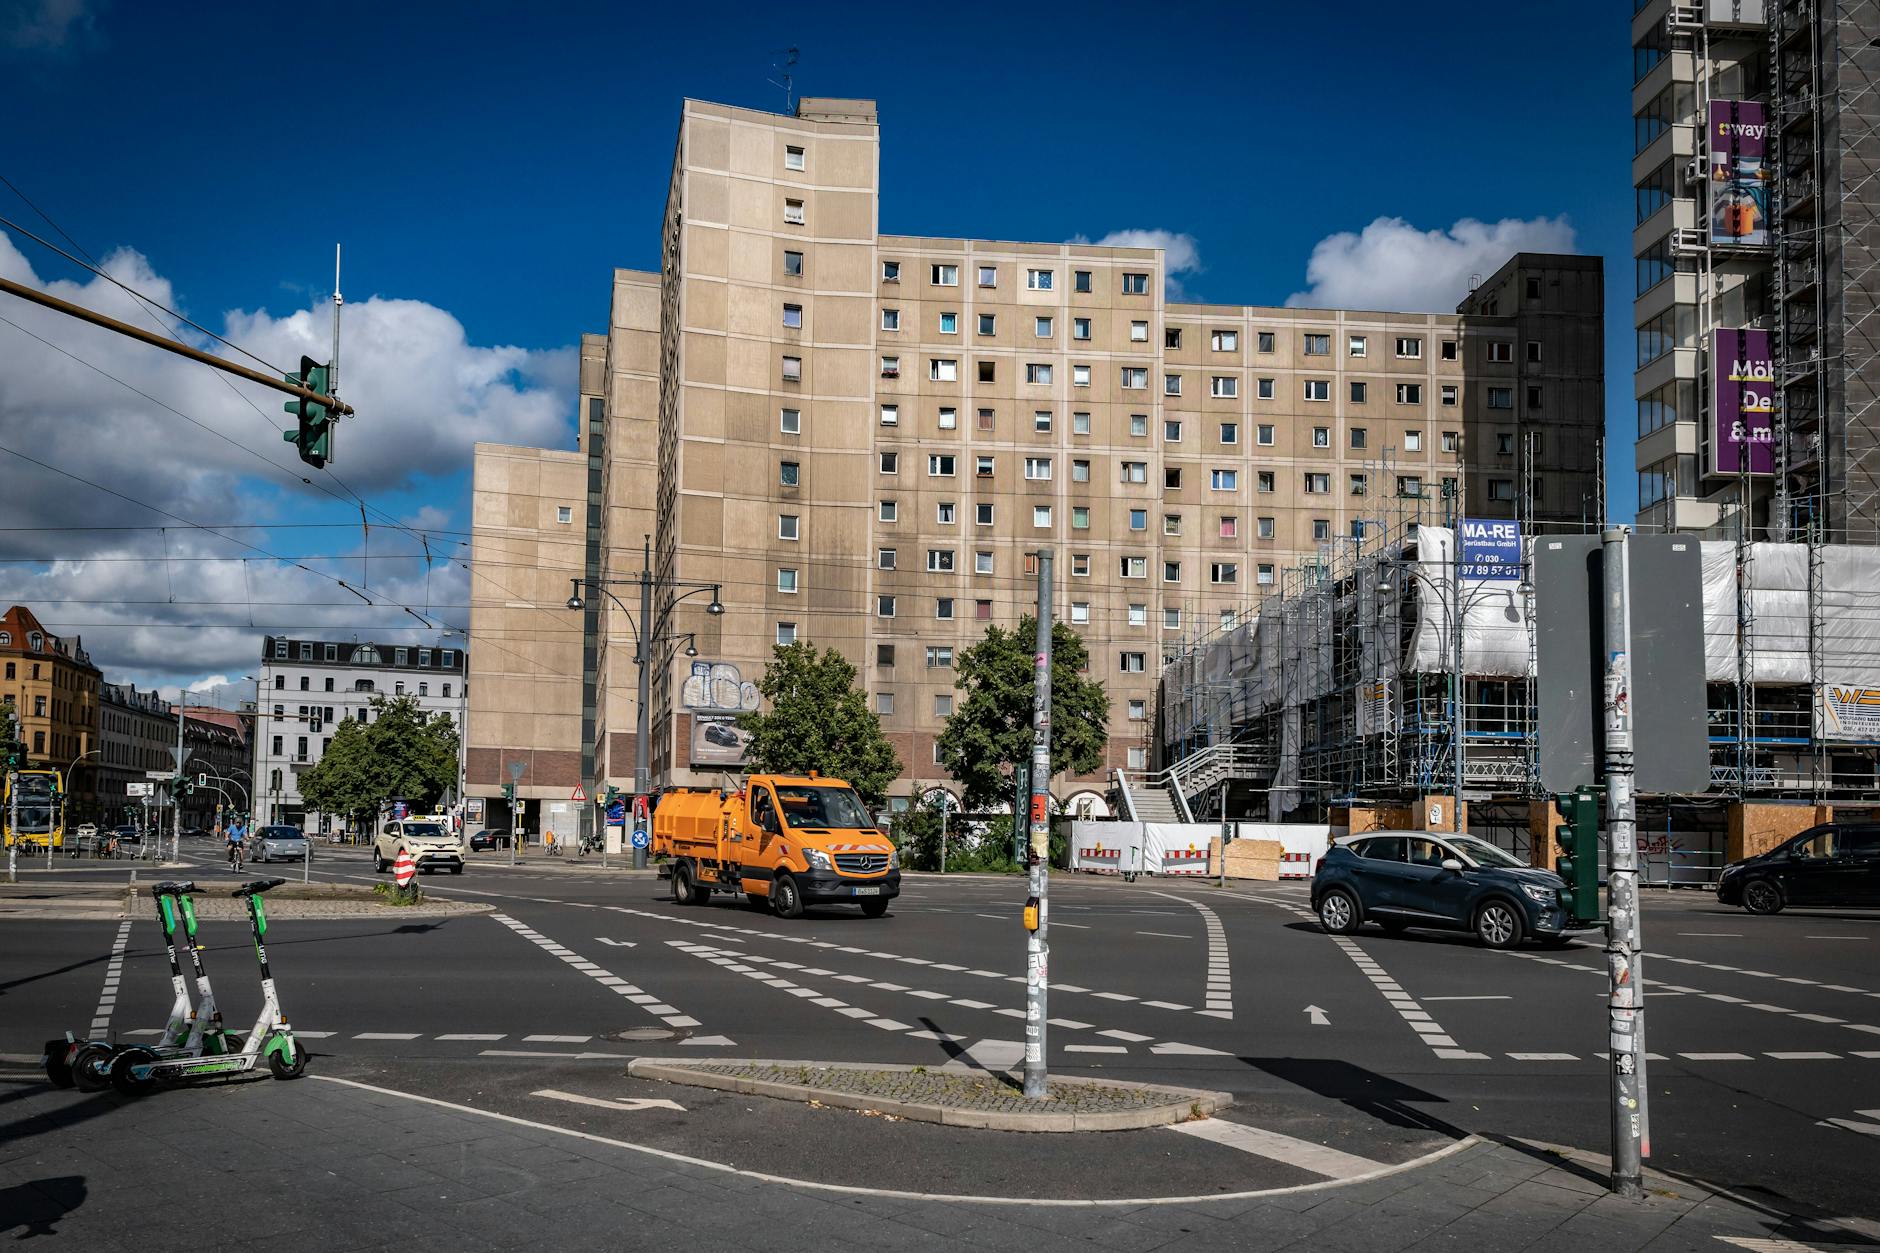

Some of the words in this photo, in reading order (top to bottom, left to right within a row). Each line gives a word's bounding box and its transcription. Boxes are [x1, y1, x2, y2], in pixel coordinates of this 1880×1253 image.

[1462, 524, 1515, 538] MA-RE
[1462, 565, 1474, 575] 97
[1476, 566, 1488, 575] 89
[190, 947, 200, 966] Lime
[259, 945, 267, 964] Lime
